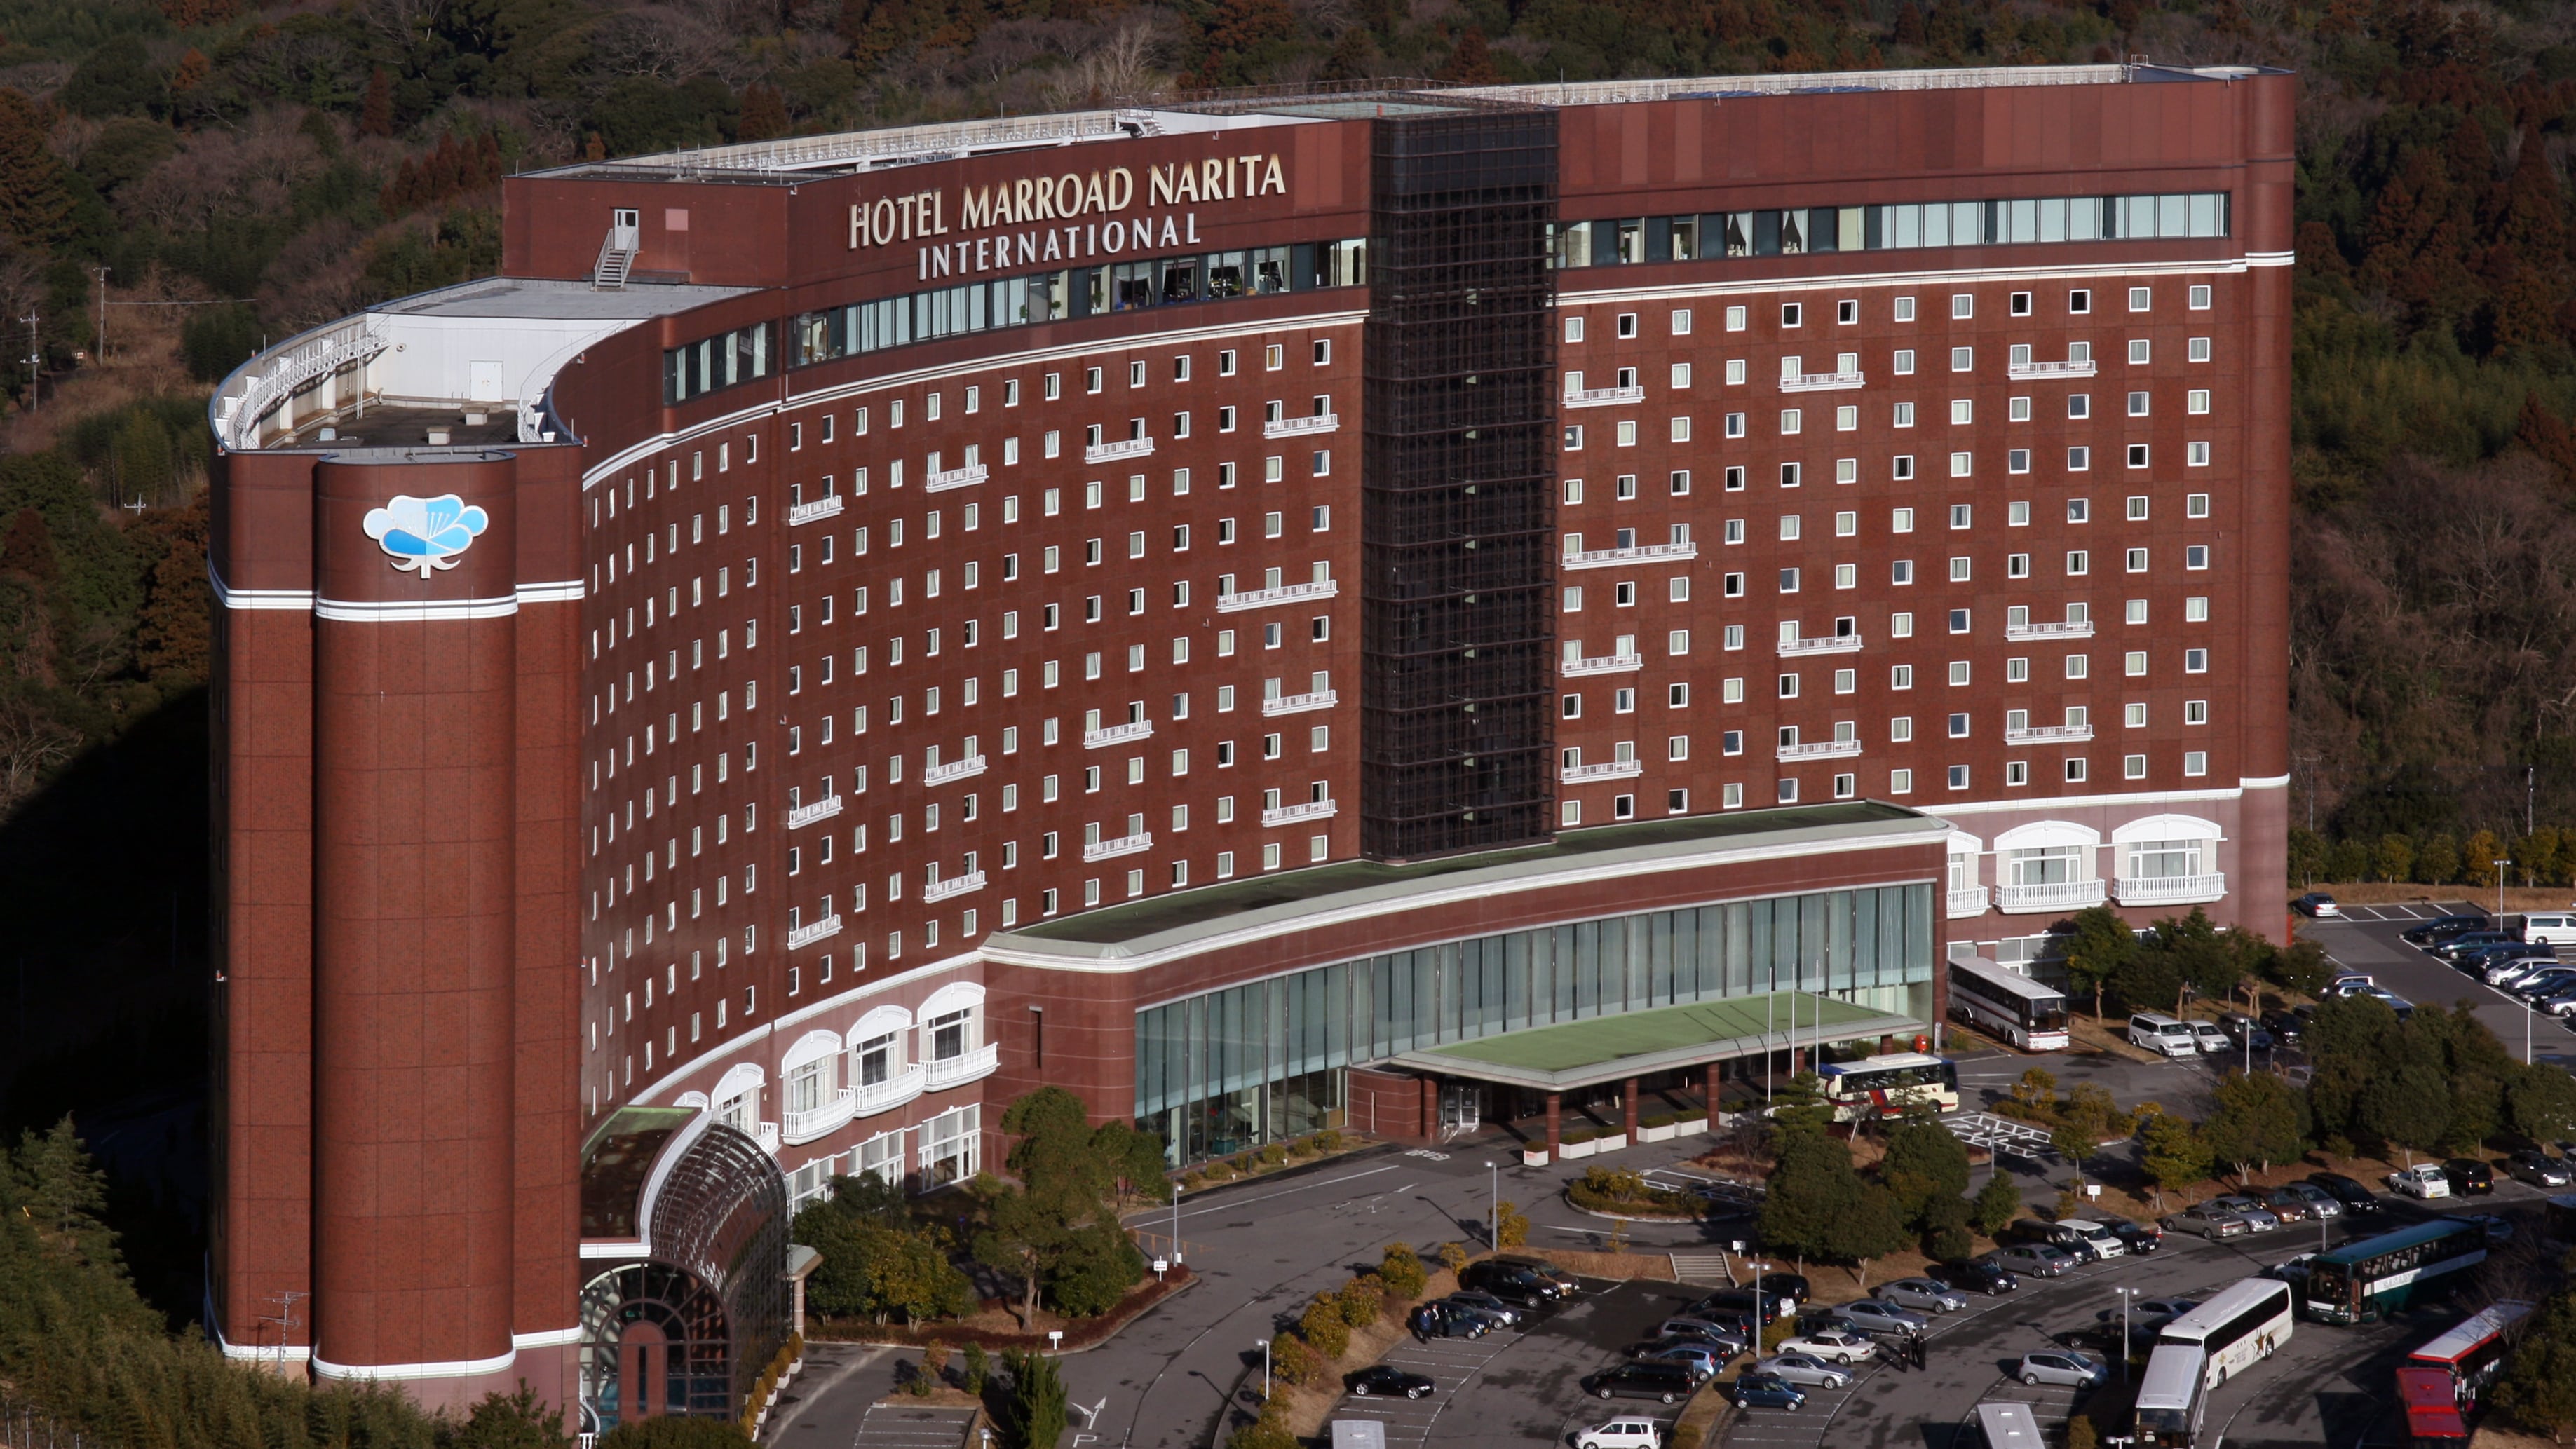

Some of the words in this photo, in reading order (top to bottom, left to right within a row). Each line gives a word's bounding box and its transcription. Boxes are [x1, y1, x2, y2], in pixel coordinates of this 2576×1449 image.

[849, 190, 948, 249] HOTEL
[961, 166, 1133, 230] MARROAD
[1150, 154, 1286, 206] NARITA
[918, 212, 1201, 280] INTERNATIONAL
[1073, 1434, 1097, 1448] P
